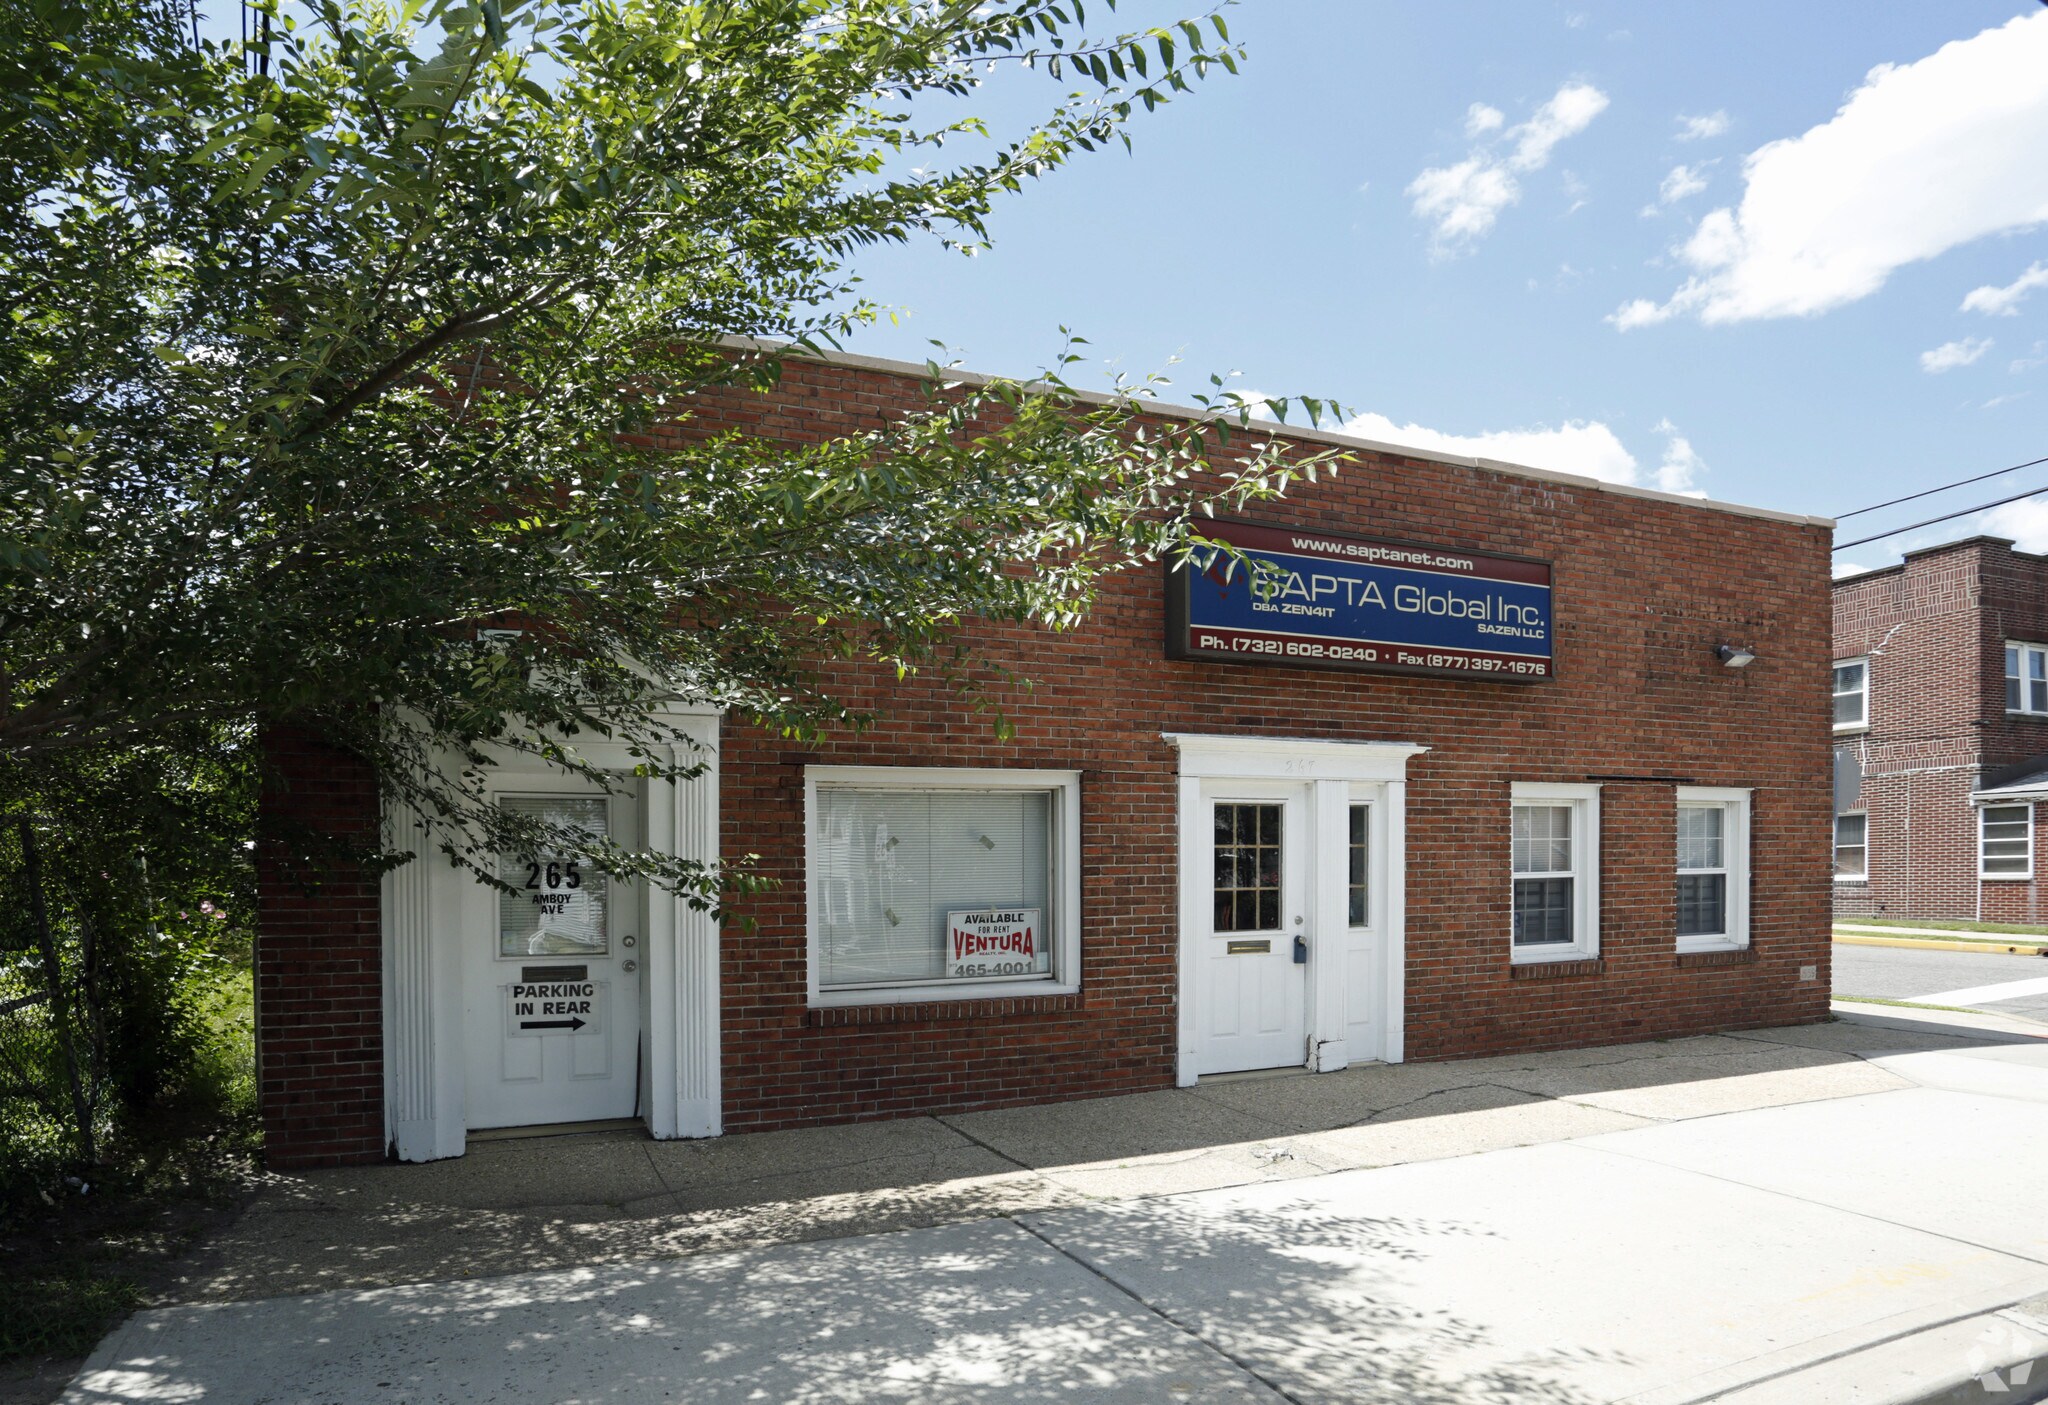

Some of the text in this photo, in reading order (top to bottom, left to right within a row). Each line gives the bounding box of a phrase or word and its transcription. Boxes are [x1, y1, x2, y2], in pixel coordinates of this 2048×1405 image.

[1291, 537, 1474, 570] www.saptanet.com
[1253, 568, 1545, 627] SAPTA Global Inc.
[1252, 601, 1336, 618] DBA ZEN4IT
[1477, 623, 1545, 640] SAZEN LLC
[1200, 635, 1546, 676] Ph. (732) 602-0240 Fax (877) 397-1676
[525, 861, 581, 890] 265
[531, 893, 572, 905] AMBOY
[540, 903, 565, 915] AVE
[964, 912, 1025, 925] AVAILABLE
[978, 925, 1010, 934] FOR RENT
[953, 926, 1034, 961] VENTURA
[955, 961, 1032, 977] 465-4001
[513, 984, 594, 999] PARKING
[515, 1000, 591, 1016] IN REAR
